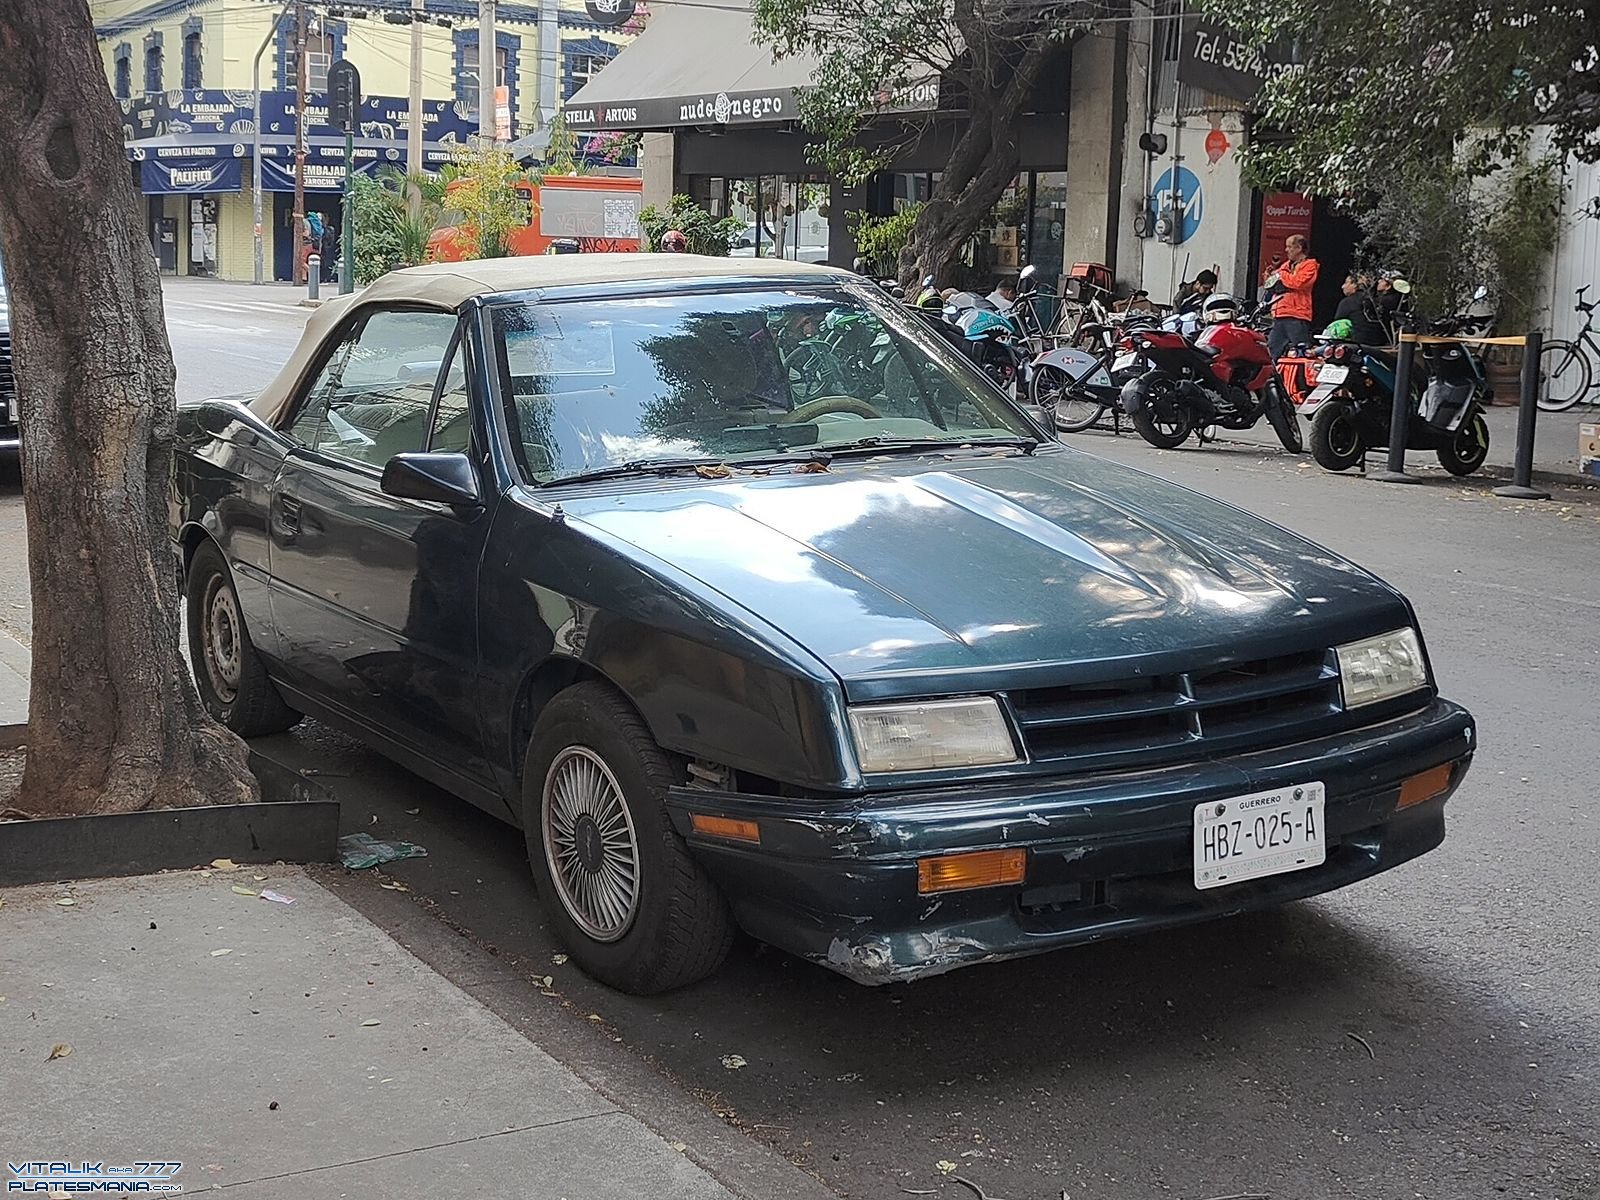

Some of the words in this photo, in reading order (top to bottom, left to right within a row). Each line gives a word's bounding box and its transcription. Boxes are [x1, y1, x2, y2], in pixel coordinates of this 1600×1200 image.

[1193, 31, 1220, 65] Tel:
[180, 103, 191, 113] LA
[192, 103, 235, 113] EMBAJADA
[284, 104, 296, 115] LA
[680, 98, 713, 121] nudo
[731, 96, 782, 119] negro
[386, 110, 397, 120] LA
[565, 109, 595, 124] STELLA
[605, 107, 637, 122] ARTOIS
[158, 147, 182, 157] CERVEZA
[320, 147, 345, 156] CERVEZA
[286, 165, 297, 176] LA
[303, 165, 346, 176] EMBAJAD
[170, 168, 212, 187] PACIFICO
[1287, 206, 1310, 216] Turbo
[1239, 795, 1281, 810] GUERRERO
[1203, 806, 1317, 863] HBZ-025-A
